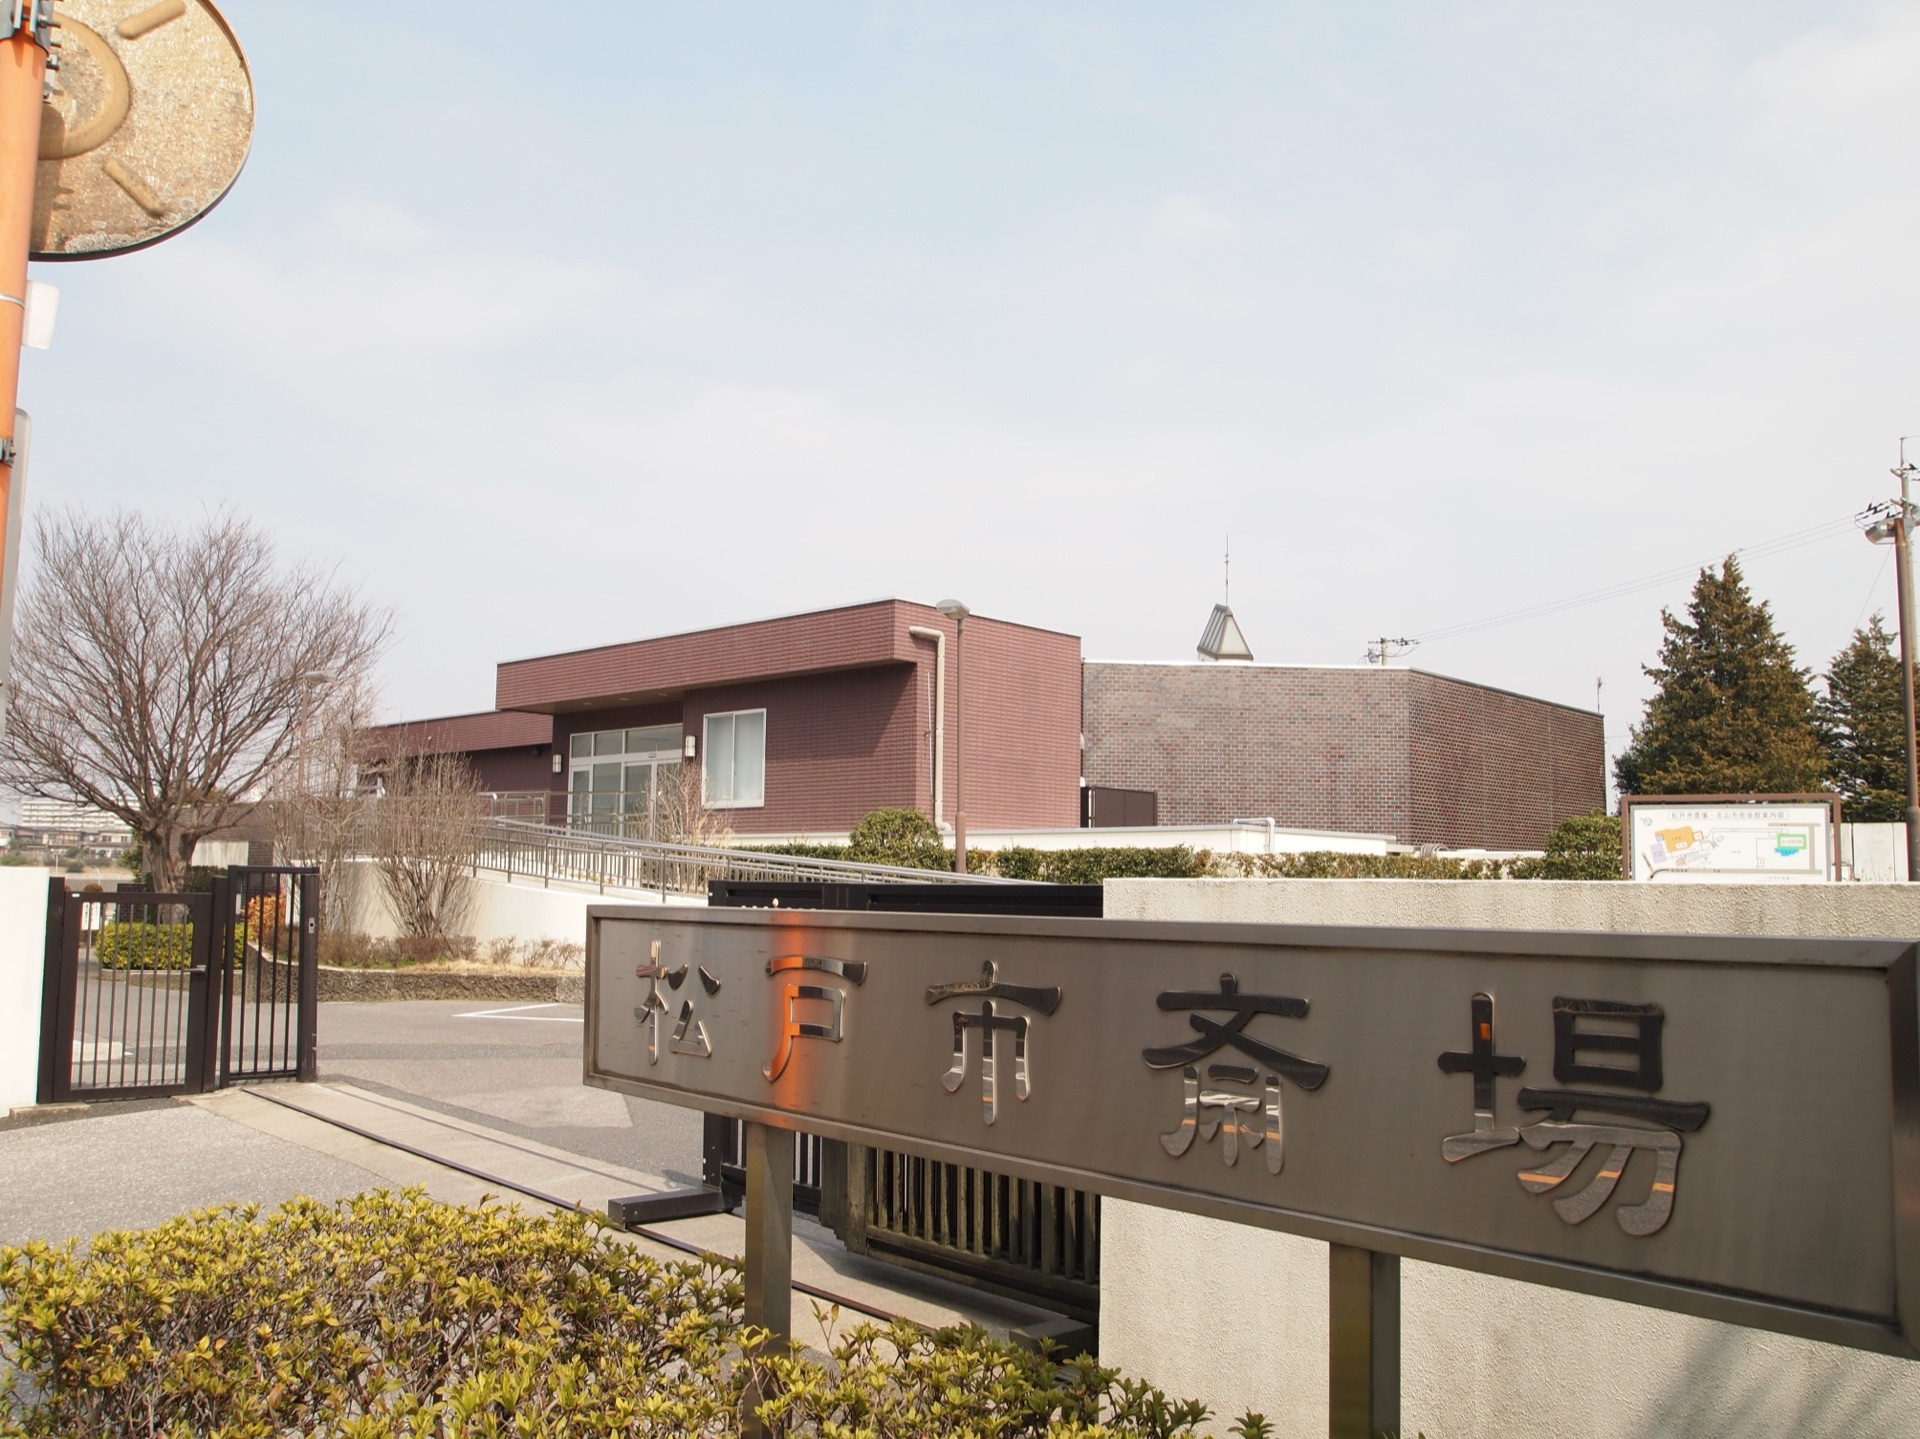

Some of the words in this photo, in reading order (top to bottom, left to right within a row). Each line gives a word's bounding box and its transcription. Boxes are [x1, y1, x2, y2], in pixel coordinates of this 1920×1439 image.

[634, 939, 1711, 1237] 松戸市斎場
